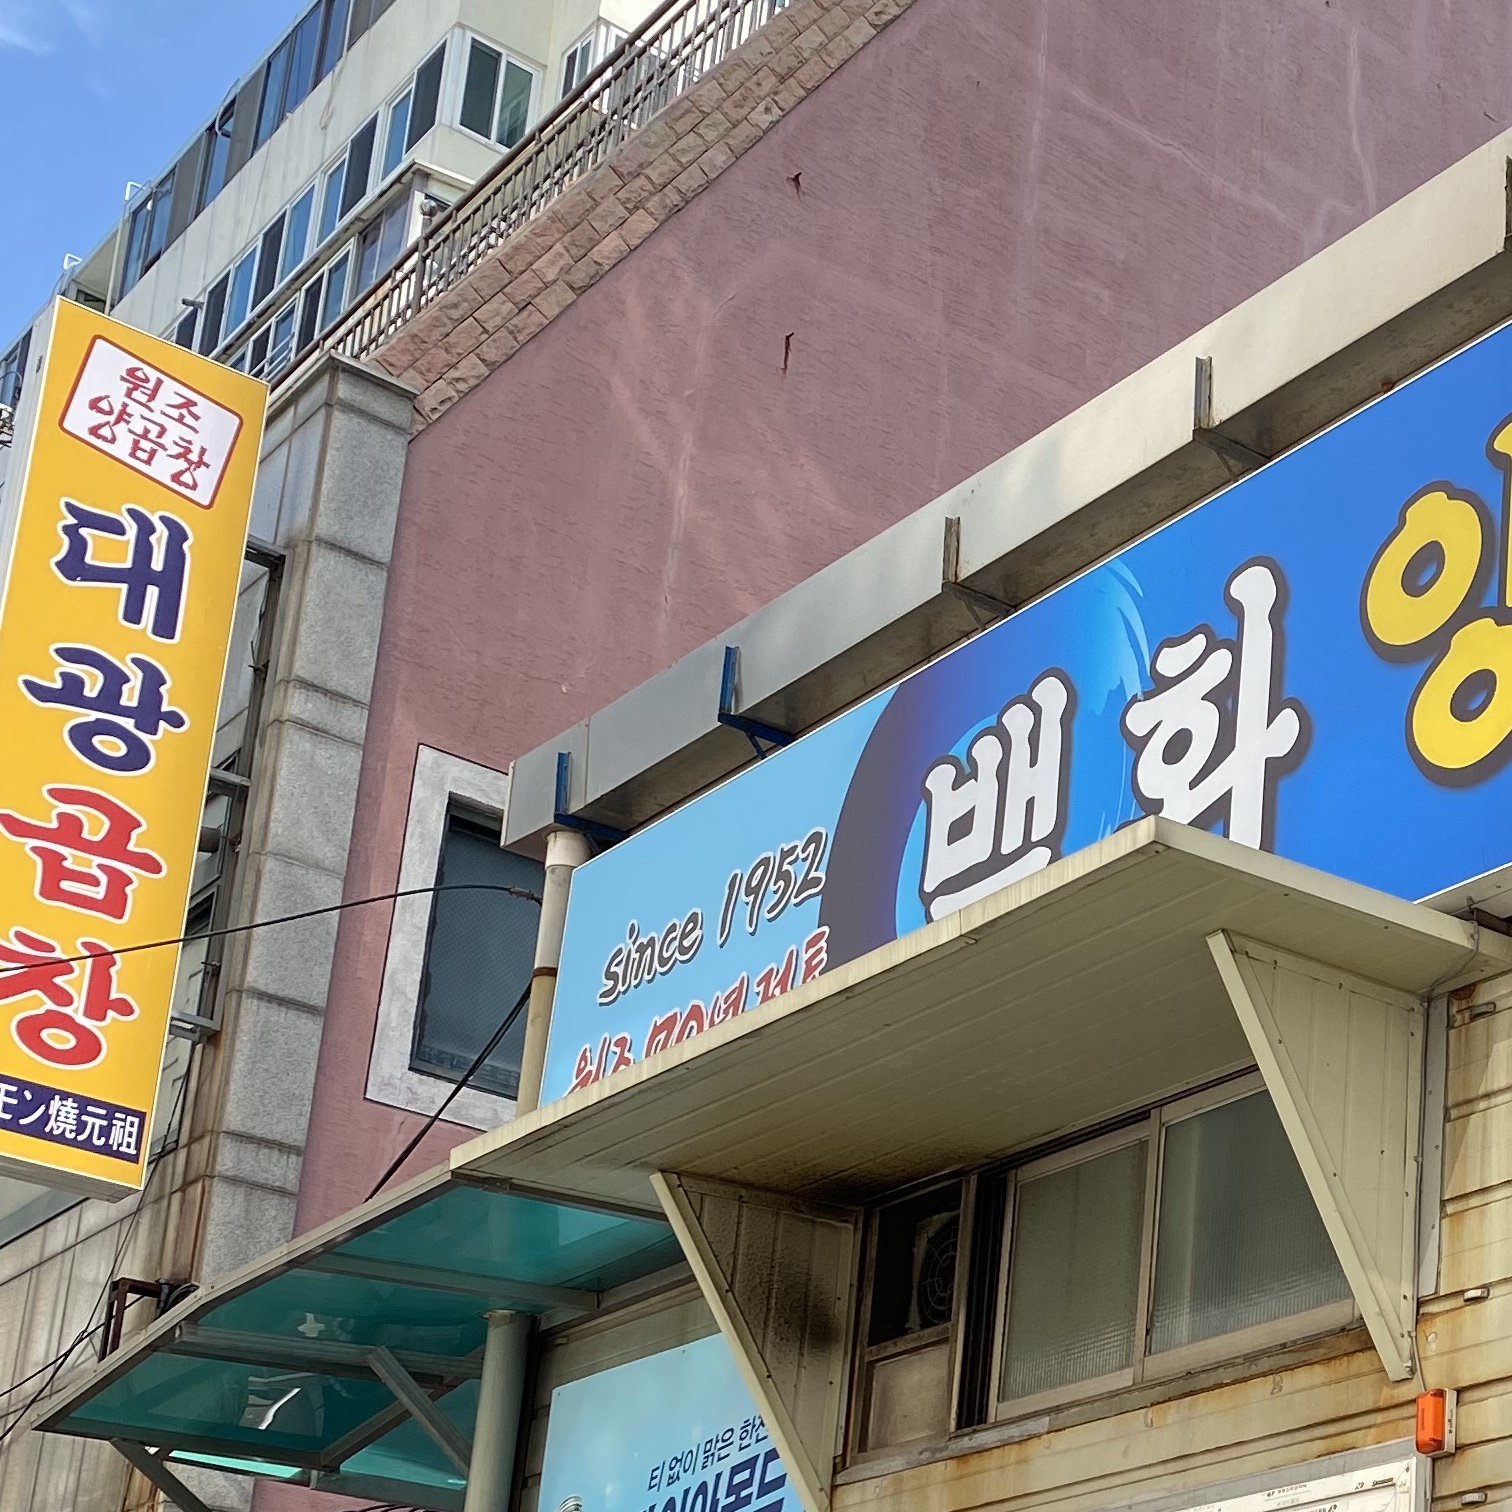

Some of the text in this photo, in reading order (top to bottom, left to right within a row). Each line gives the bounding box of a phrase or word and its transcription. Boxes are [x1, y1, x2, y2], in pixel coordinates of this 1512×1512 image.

[87, 395, 211, 491] 양곱창
[119, 365, 202, 435] 원조
[922, 562, 1303, 923] 백화
[598, 828, 827, 1004] since 1952
